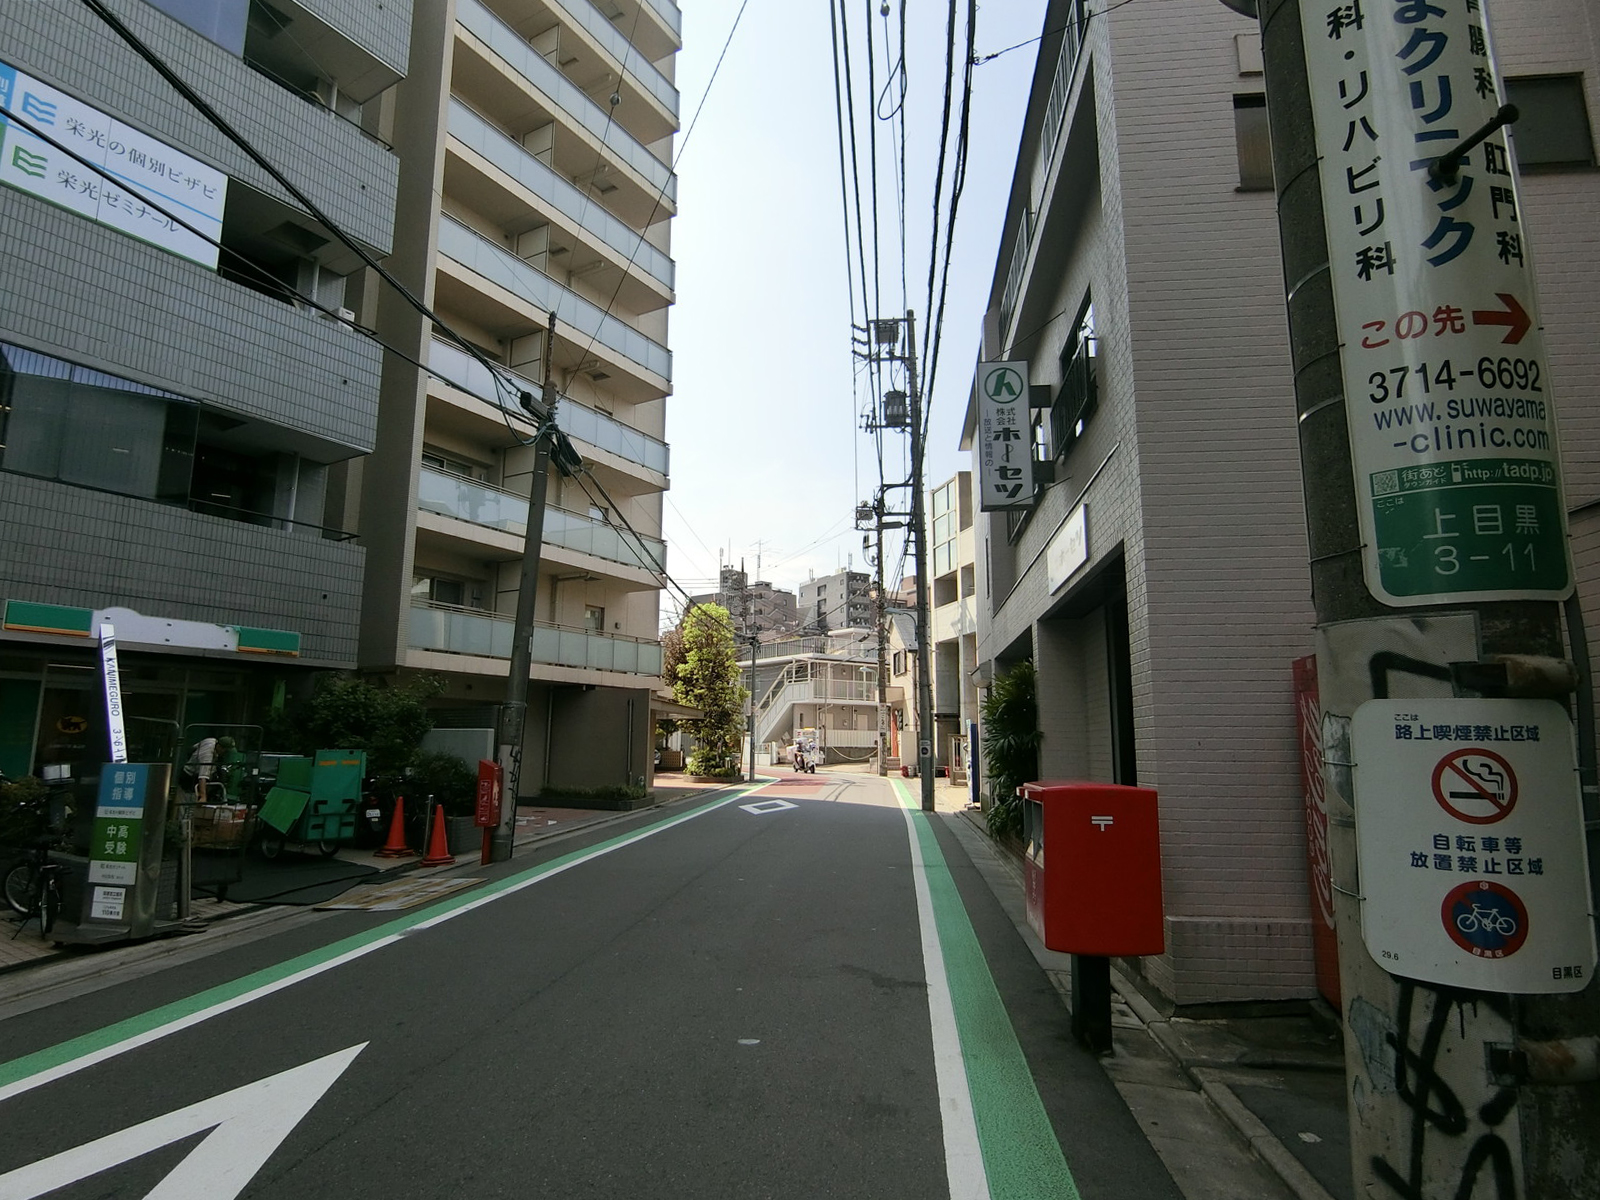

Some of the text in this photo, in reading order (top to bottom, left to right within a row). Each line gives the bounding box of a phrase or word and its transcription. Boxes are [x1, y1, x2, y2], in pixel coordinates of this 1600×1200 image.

[66, 116, 217, 200] 栄光の個別ビザビ
[57, 169, 179, 233] 栄光ゼミナール
[1361, 305, 1465, 349] この先
[1368, 357, 1542, 404] 3714-6692
[996, 407, 1016, 416] 株式
[1374, 397, 1546, 430] www.suwayama
[996, 417, 1016, 426] 会社
[1393, 422, 1549, 453] -clinic.com
[1401, 466, 1446, 481] 街あど
[1377, 496, 1404, 508] ここは
[1423, 504, 1541, 539] 上目黒
[1434, 542, 1537, 575] 3-11
[1394, 713, 1419, 721] ここは
[1395, 724, 1540, 742] 路上喫煙禁止区域
[114, 771, 137, 785] 個別
[112, 788, 134, 801] 指導
[106, 825, 129, 838] 中高
[104, 841, 127, 855] 受験
[1433, 833, 1522, 855] 自転車等
[1410, 851, 1544, 876] 放置禁止区域
[1381, 950, 1399, 961] 29.6
[1552, 965, 1583, 980] 目黒区
